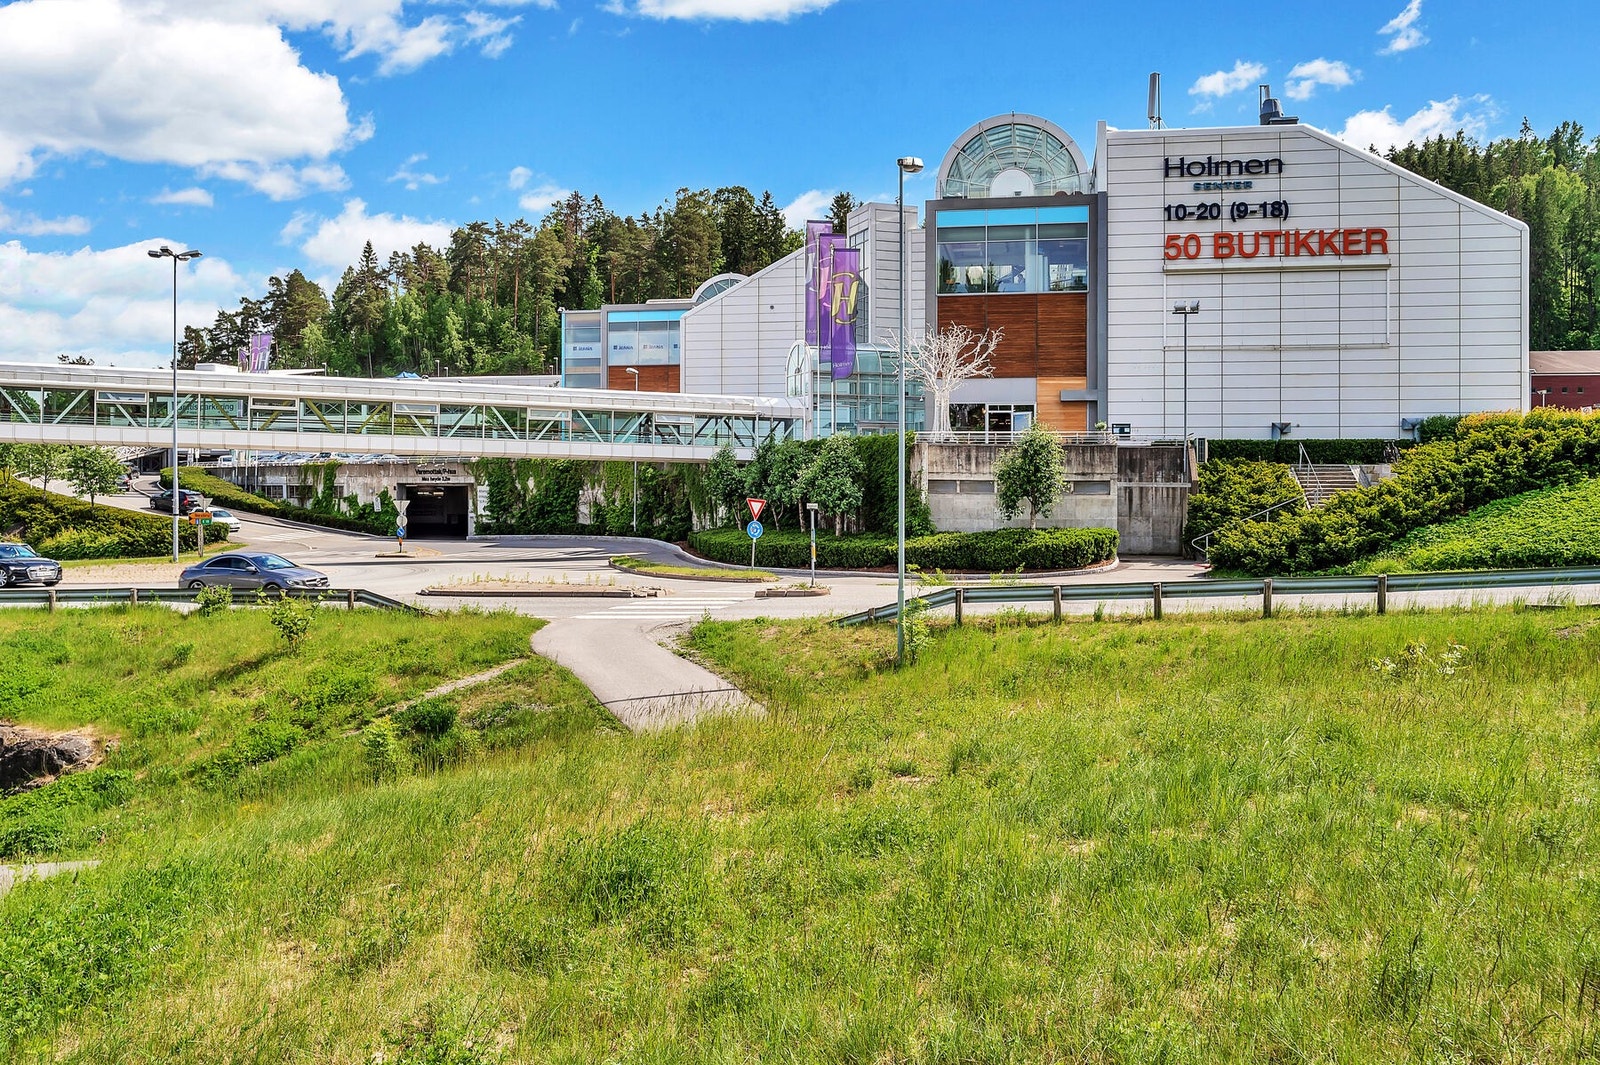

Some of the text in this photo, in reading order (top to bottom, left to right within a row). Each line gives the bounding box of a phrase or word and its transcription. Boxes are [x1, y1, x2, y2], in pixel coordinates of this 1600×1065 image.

[1164, 156, 1283, 177] Holmen
[1193, 180, 1253, 191] SENTER
[1164, 200, 1289, 222] 10-20 (9-18)
[1164, 228, 1389, 260] 50 BUTIKKER
